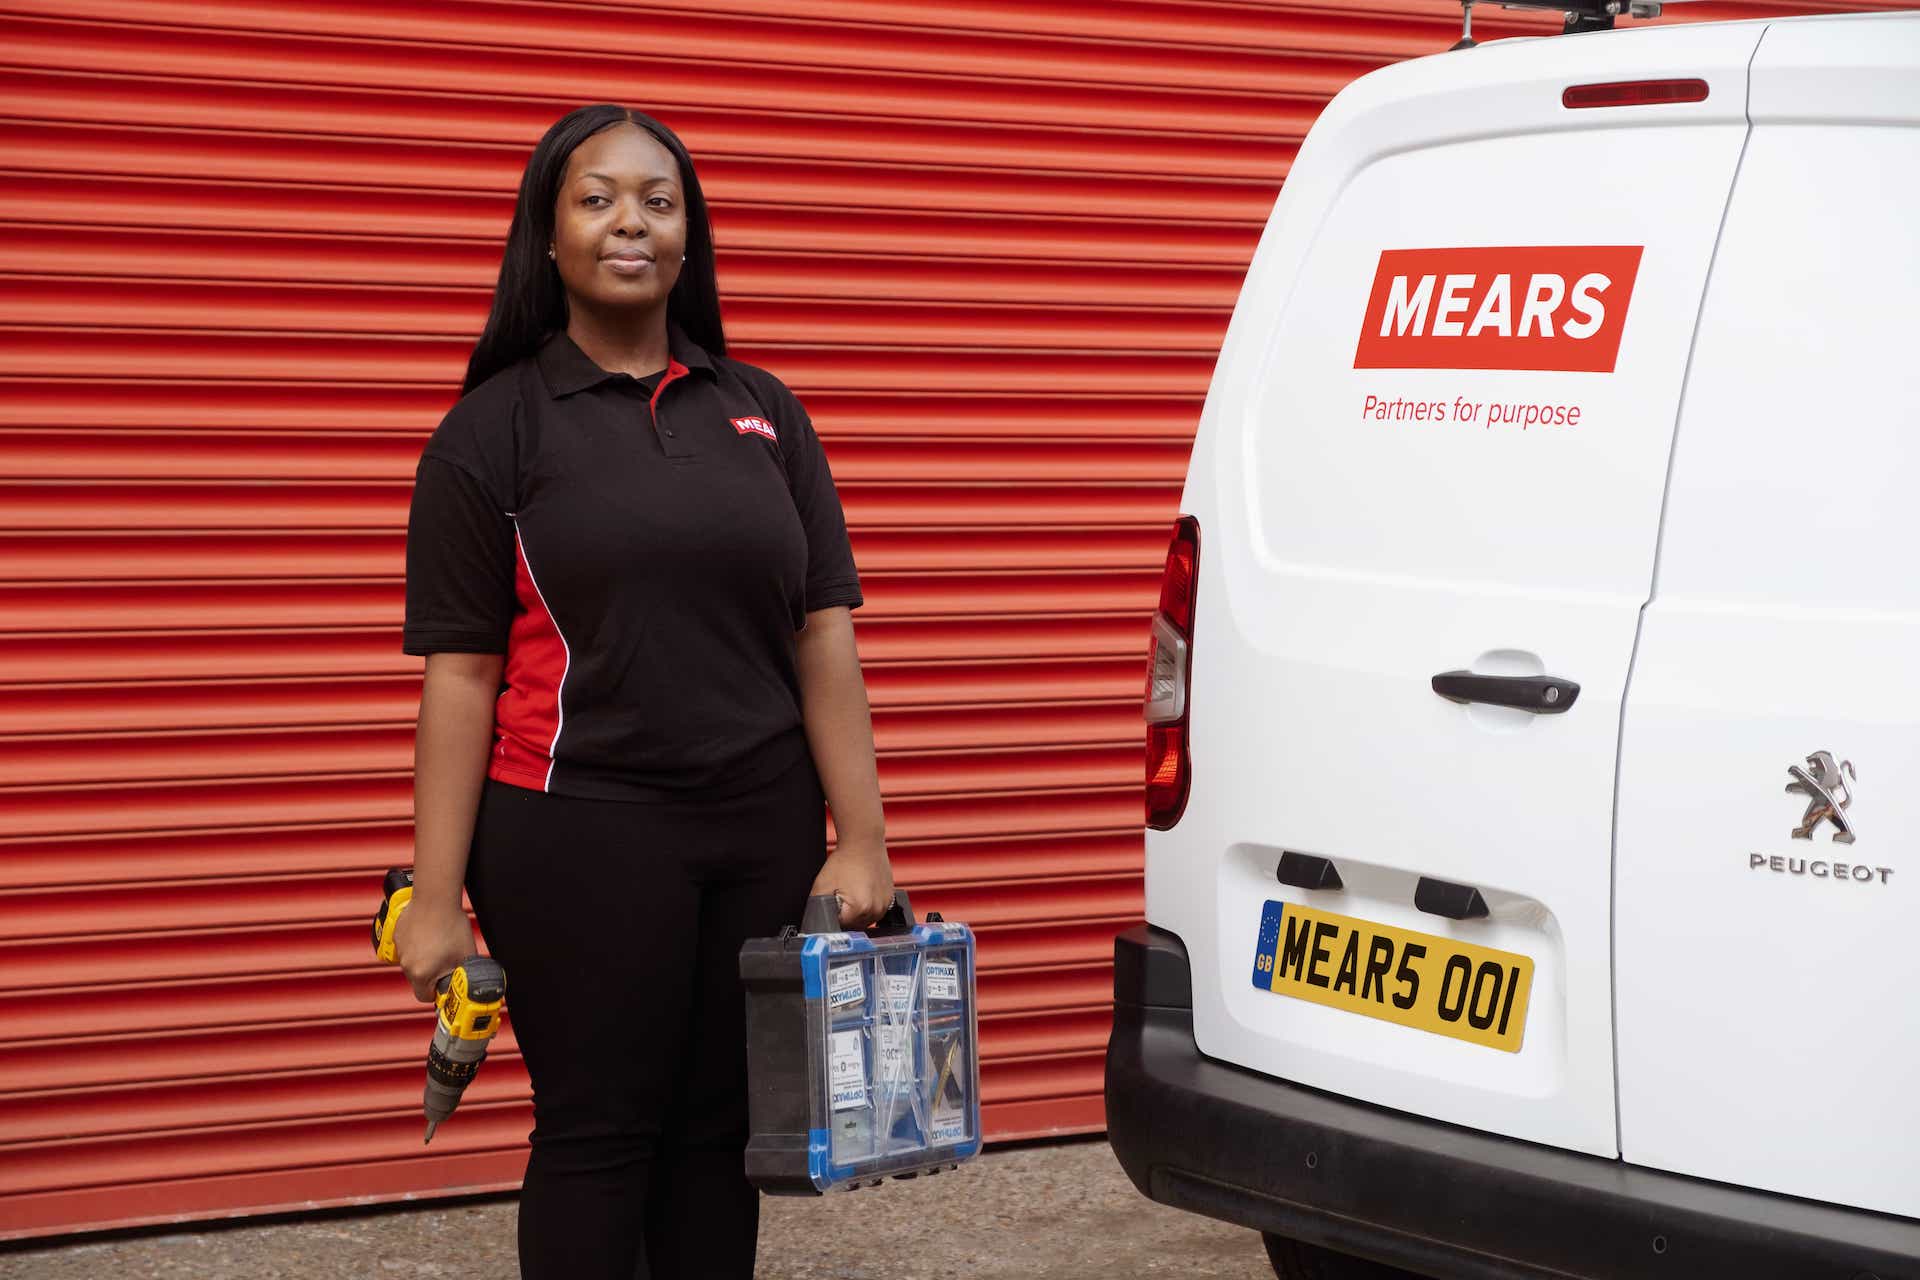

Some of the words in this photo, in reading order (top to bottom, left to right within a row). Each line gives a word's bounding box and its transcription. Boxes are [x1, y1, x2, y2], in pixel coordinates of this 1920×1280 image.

[1379, 272, 1613, 340] MEARS
[1362, 394, 1447, 422] Partners
[1453, 395, 1482, 423] for
[1486, 402, 1582, 431] purpose
[1749, 853, 1895, 885] PEUGEOT
[927, 966, 956, 976] OPTIMAXX
[1257, 953, 1273, 973] GB
